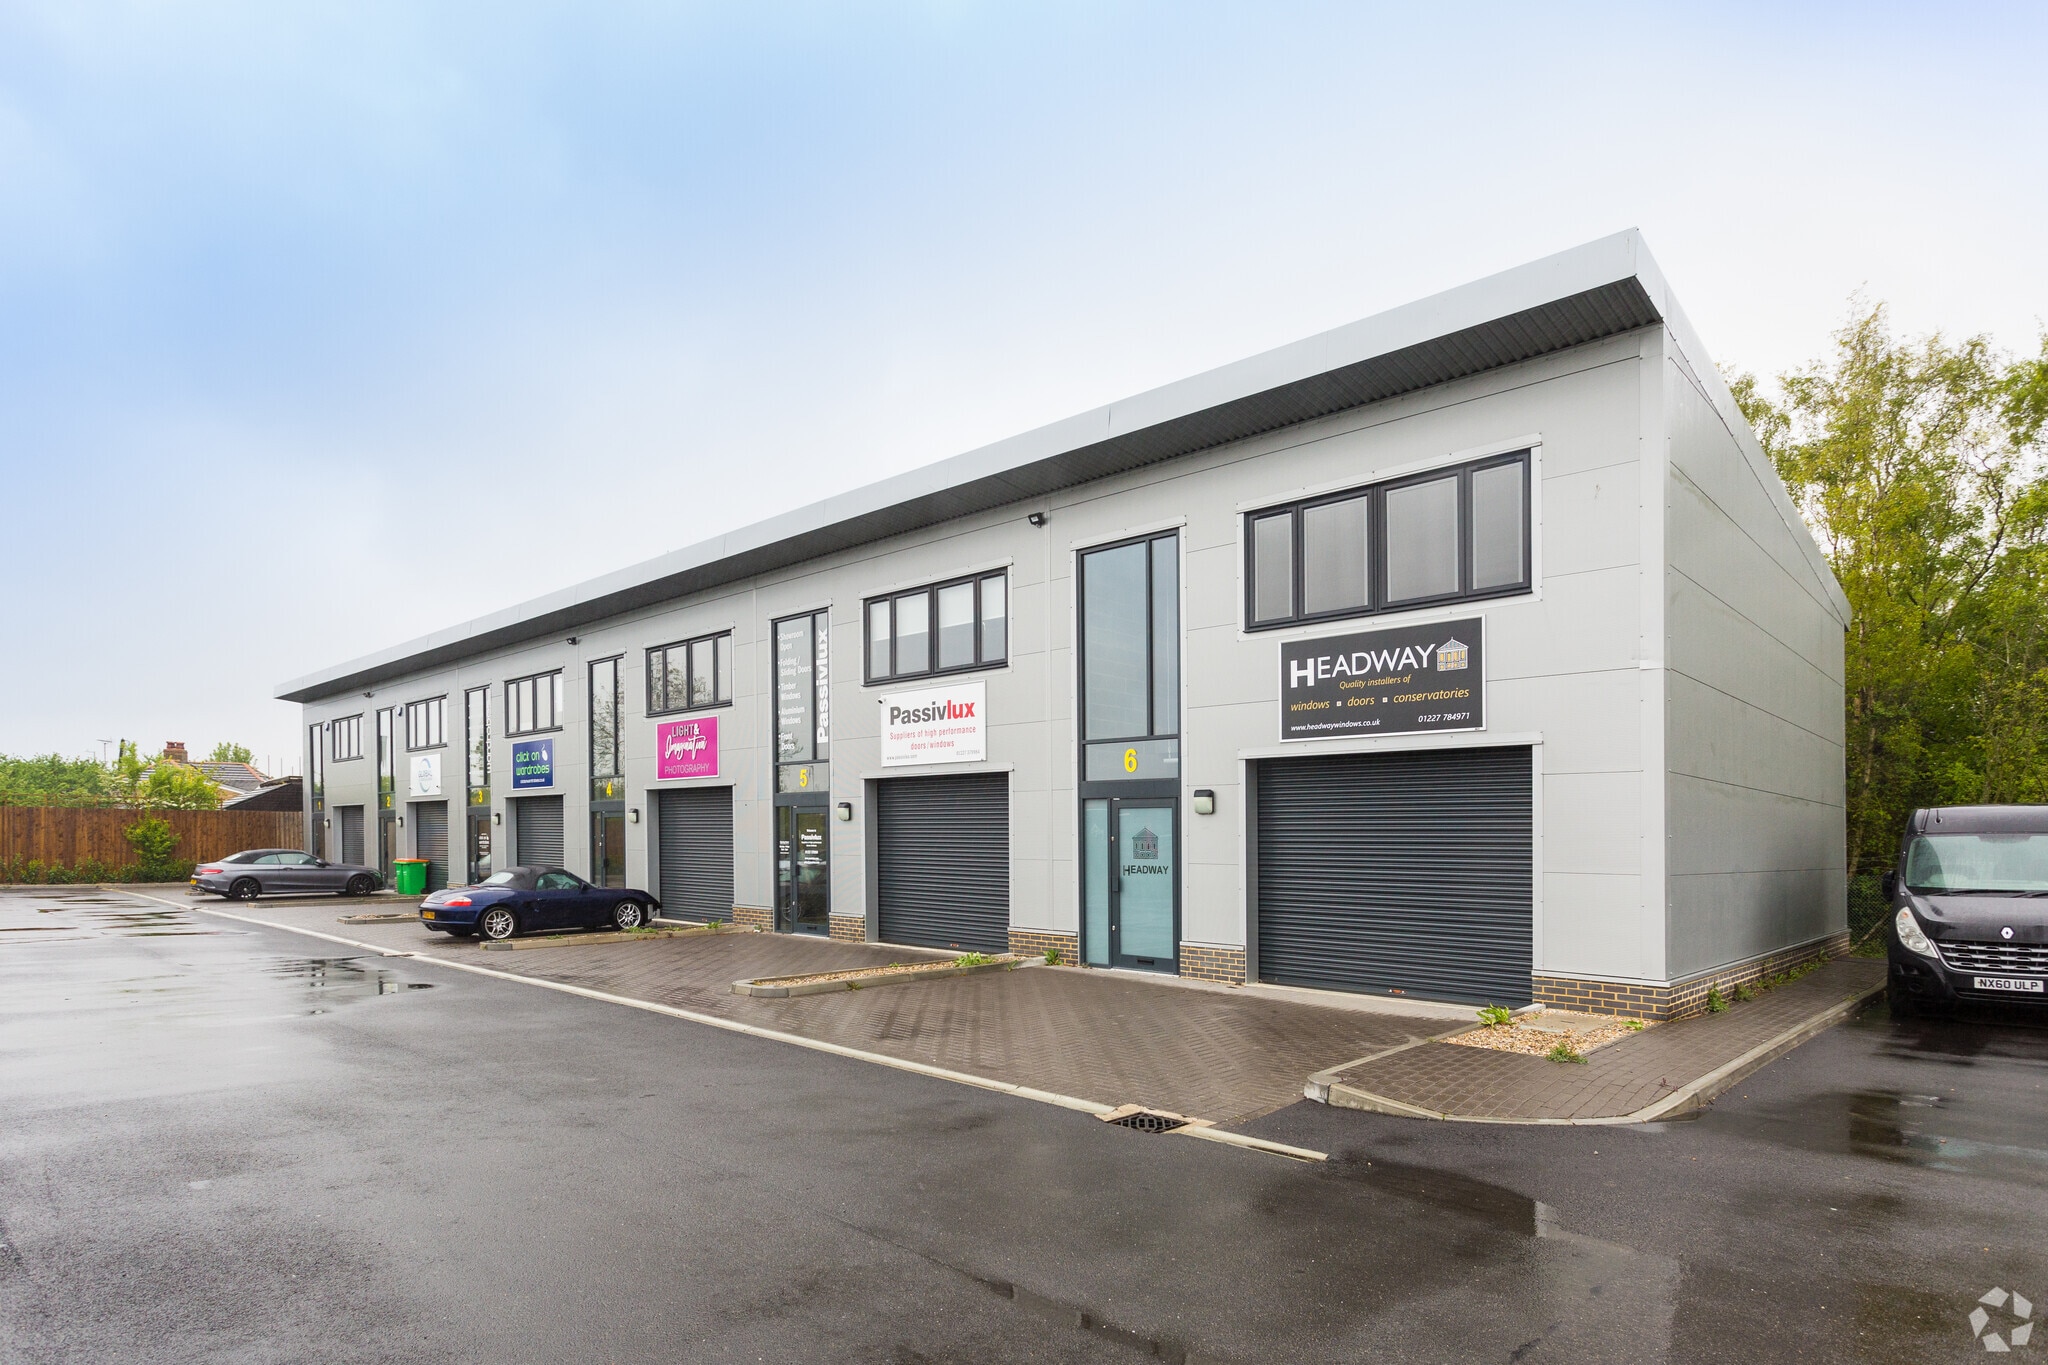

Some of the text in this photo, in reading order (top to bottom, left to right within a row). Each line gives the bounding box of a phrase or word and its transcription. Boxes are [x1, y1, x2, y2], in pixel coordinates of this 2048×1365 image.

[780, 643, 792, 652] Open
[798, 665, 812, 673] Doors
[1290, 644, 1436, 688] HEADWAY
[780, 682, 796, 691] Timber
[816, 628, 829, 744] Passivlux
[1339, 674, 1412, 690] Quality installers of
[780, 692, 801, 701] Windows
[1290, 688, 1469, 712] windows doors conservatories
[890, 700, 975, 725] Passivlux
[1418, 712, 1470, 723] 01227 784971
[780, 716, 801, 726] Windows
[1290, 718, 1381, 731] www.headwaywindows.co.uk
[890, 726, 976, 741] Suppliers of high performance
[781, 742, 795, 750] Doors
[516, 751, 540, 762] click on
[1124, 748, 1138, 773] 6
[516, 764, 550, 776] wardrobes
[665, 763, 709, 774] PHOTOGRAPHY
[800, 769, 808, 787] 5
[606, 782, 613, 796] 4
[386, 796, 391, 807] 2
[478, 790, 483, 803] 3
[1123, 865, 1169, 876] HEADWAY
[1979, 979, 2038, 991] NX60 ULP
